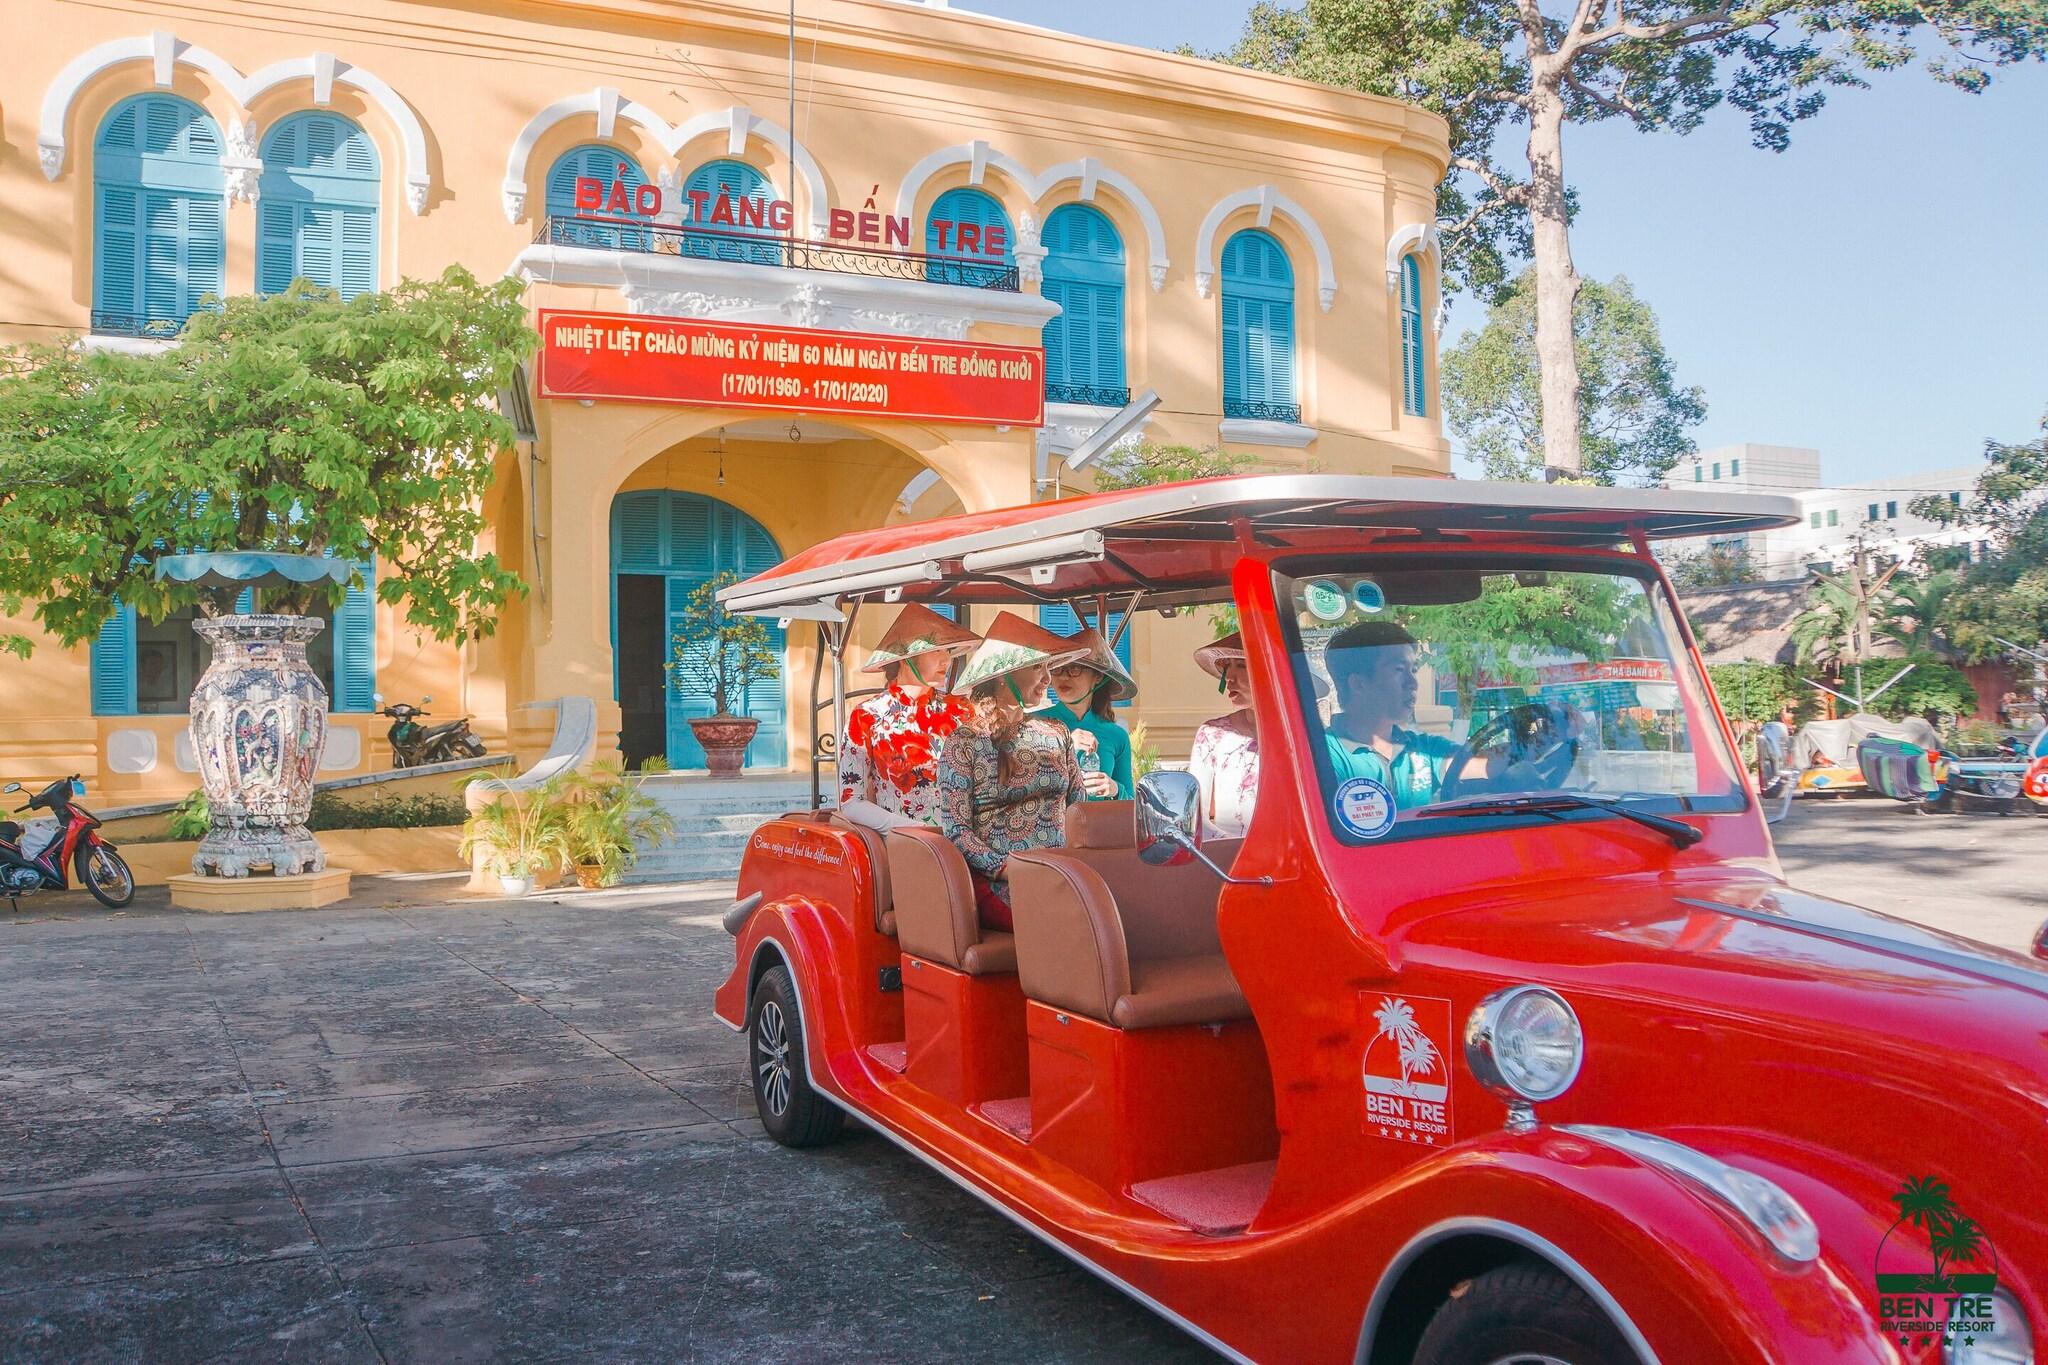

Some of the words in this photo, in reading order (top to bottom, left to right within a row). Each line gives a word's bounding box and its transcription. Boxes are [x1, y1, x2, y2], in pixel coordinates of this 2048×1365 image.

[575, 162, 662, 217] BẢO
[688, 182, 793, 231] TÀNG
[829, 184, 910, 246] BẾN
[932, 219, 1006, 256] TRE
[555, 324, 604, 355] NHIỆT
[607, 326, 642, 357] LIỆT
[645, 329, 688, 355] CHÀO
[691, 331, 735, 359] MỪNG
[738, 333, 760, 361] KỶ
[763, 338, 800, 368] NIỆM
[803, 344, 820, 365] 60
[823, 342, 855, 368] NĂM
[858, 346, 897, 371] NGÀY
[900, 345, 928, 373] BẾN
[931, 354, 958, 375] TRE
[960, 350, 997, 378] ĐỒNG
[1000, 355, 1032, 381] KHỞI
[722, 373, 801, 397] (17/01/1960
[813, 379, 888, 407] 17/01/2020)
[784, 842, 794, 855] and
[793, 841, 804, 859] feel
[804, 844, 813, 858] the
[813, 847, 845, 867] difference!
[1366, 1094, 1403, 1116] BEN
[1409, 1101, 1446, 1123] TRE
[1367, 1114, 1411, 1129] RIVERSIDE
[1413, 1121, 1447, 1135] RESORT
